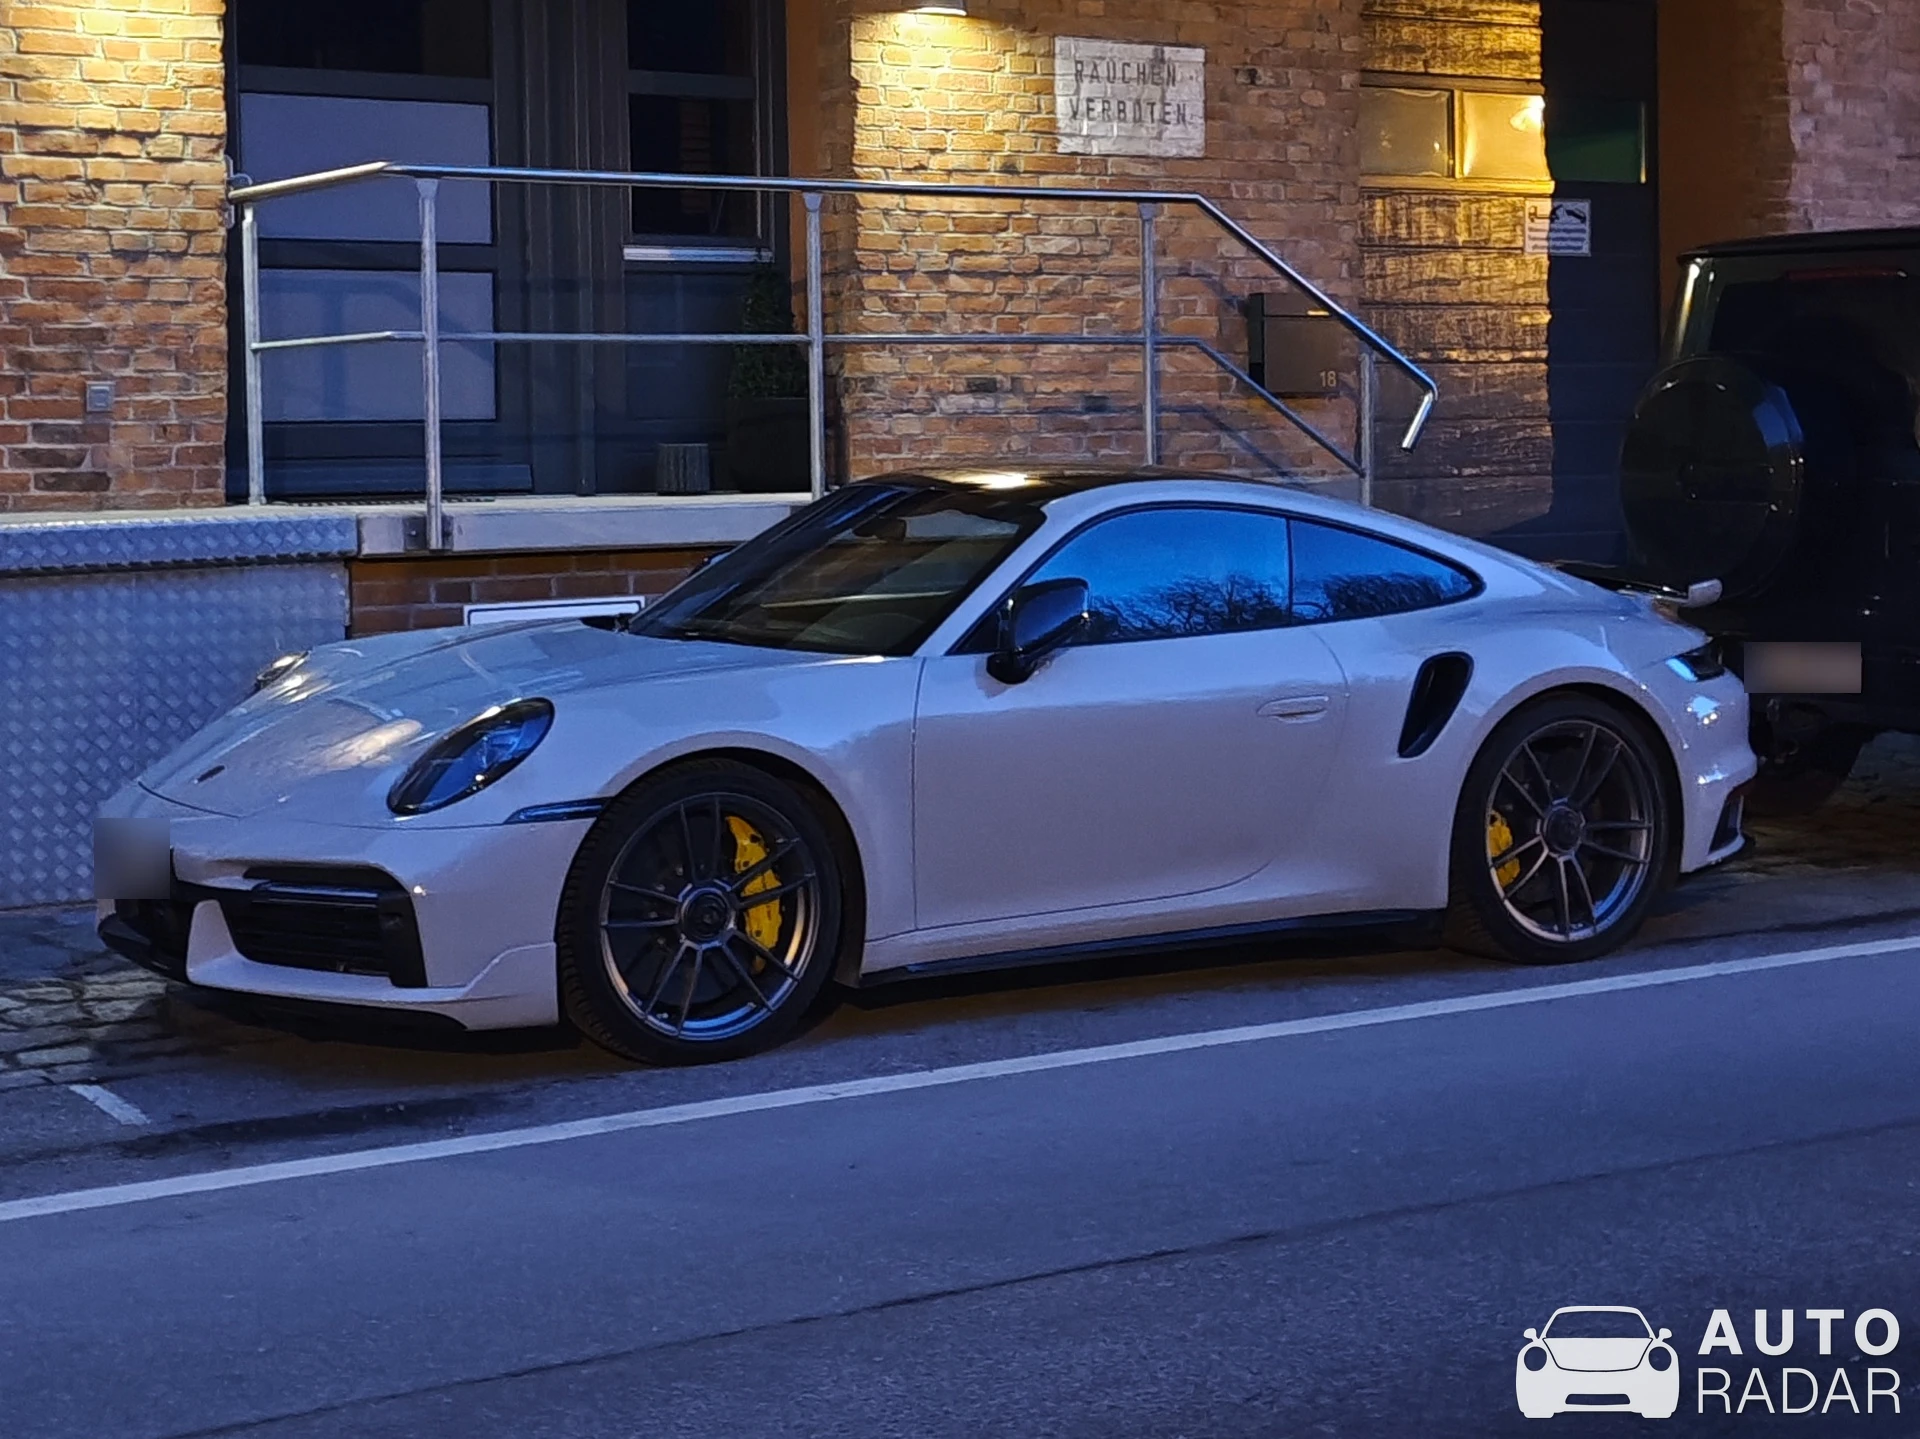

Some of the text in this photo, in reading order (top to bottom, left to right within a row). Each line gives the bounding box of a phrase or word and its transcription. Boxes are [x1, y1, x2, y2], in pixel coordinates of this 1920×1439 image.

[1075, 60, 1176, 86] RAUCHEN
[1069, 98, 1186, 125] VERBOTEN
[1320, 371, 1336, 387] 18
